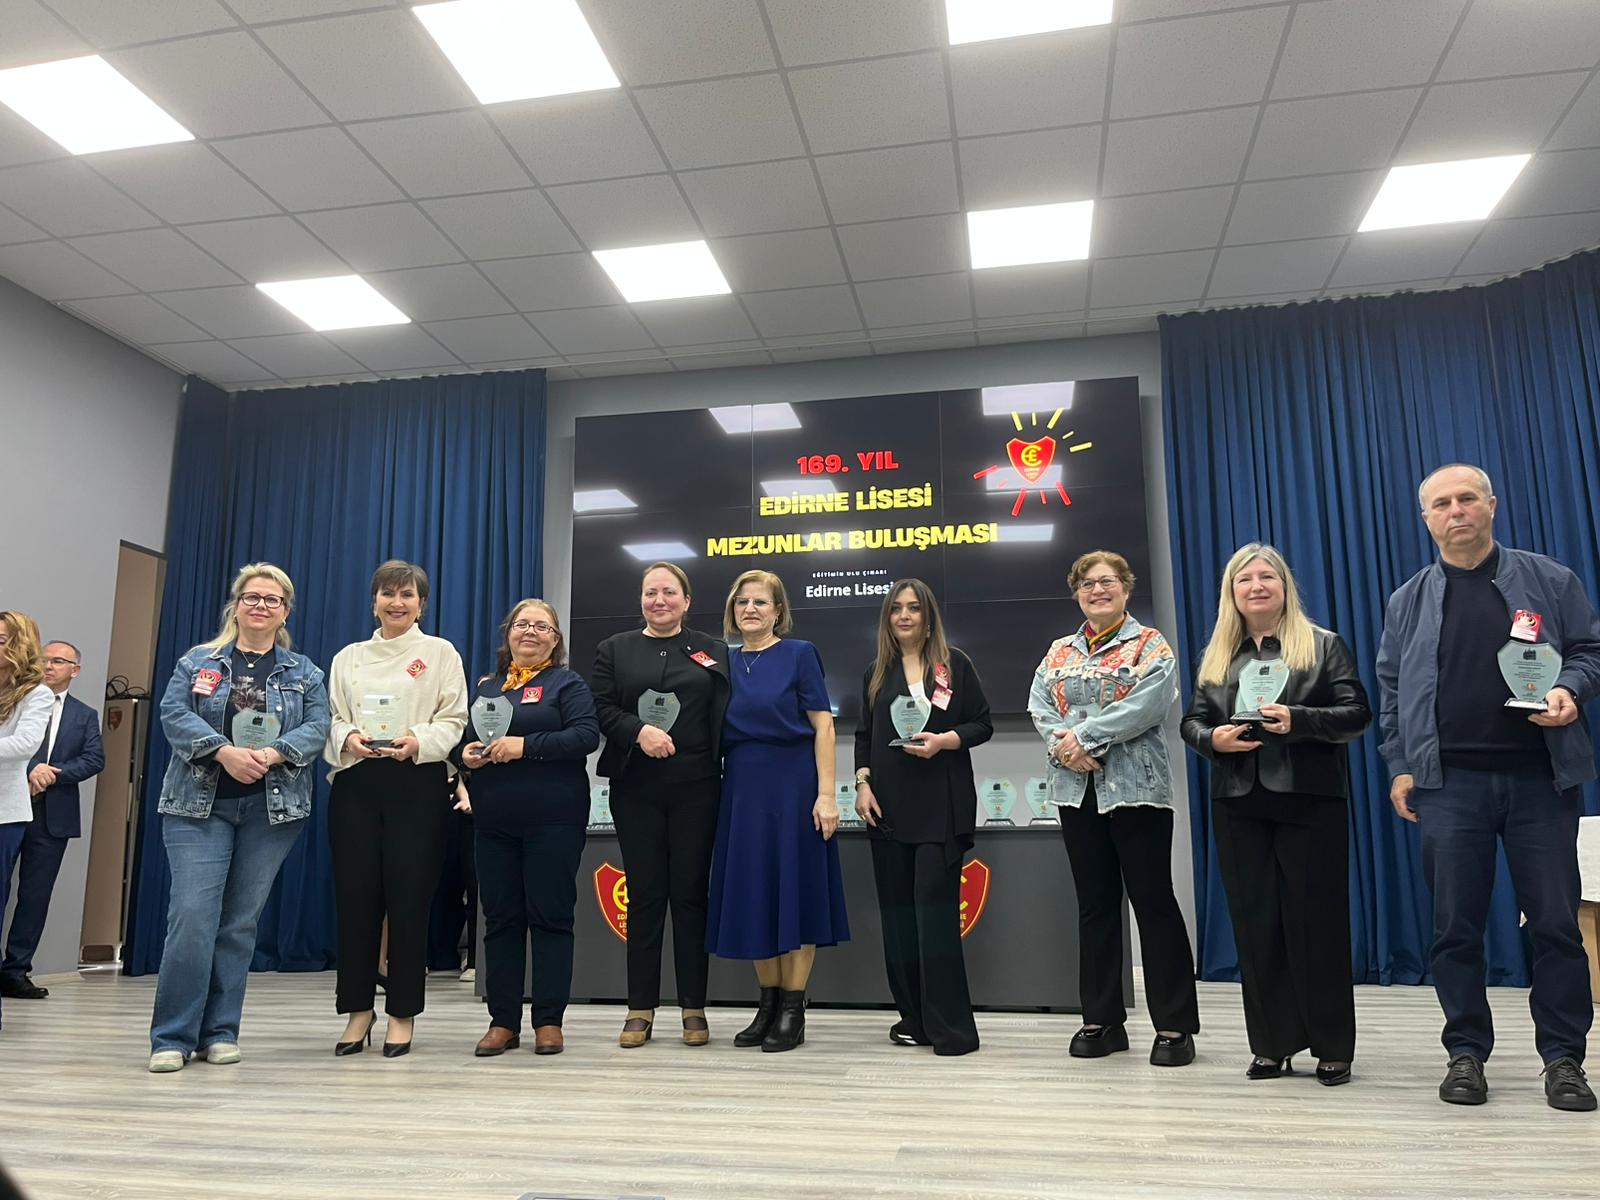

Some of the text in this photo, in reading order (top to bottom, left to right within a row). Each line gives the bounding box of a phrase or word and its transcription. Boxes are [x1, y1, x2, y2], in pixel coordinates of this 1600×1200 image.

[796, 450, 899, 475] 169. YIL
[759, 482, 933, 516] EDİRNE LİSESİ
[706, 522, 999, 557] MEZUNLAR BULUŞMASI
[862, 569, 888, 577] ÇINARI
[805, 584, 852, 598] Edirne
